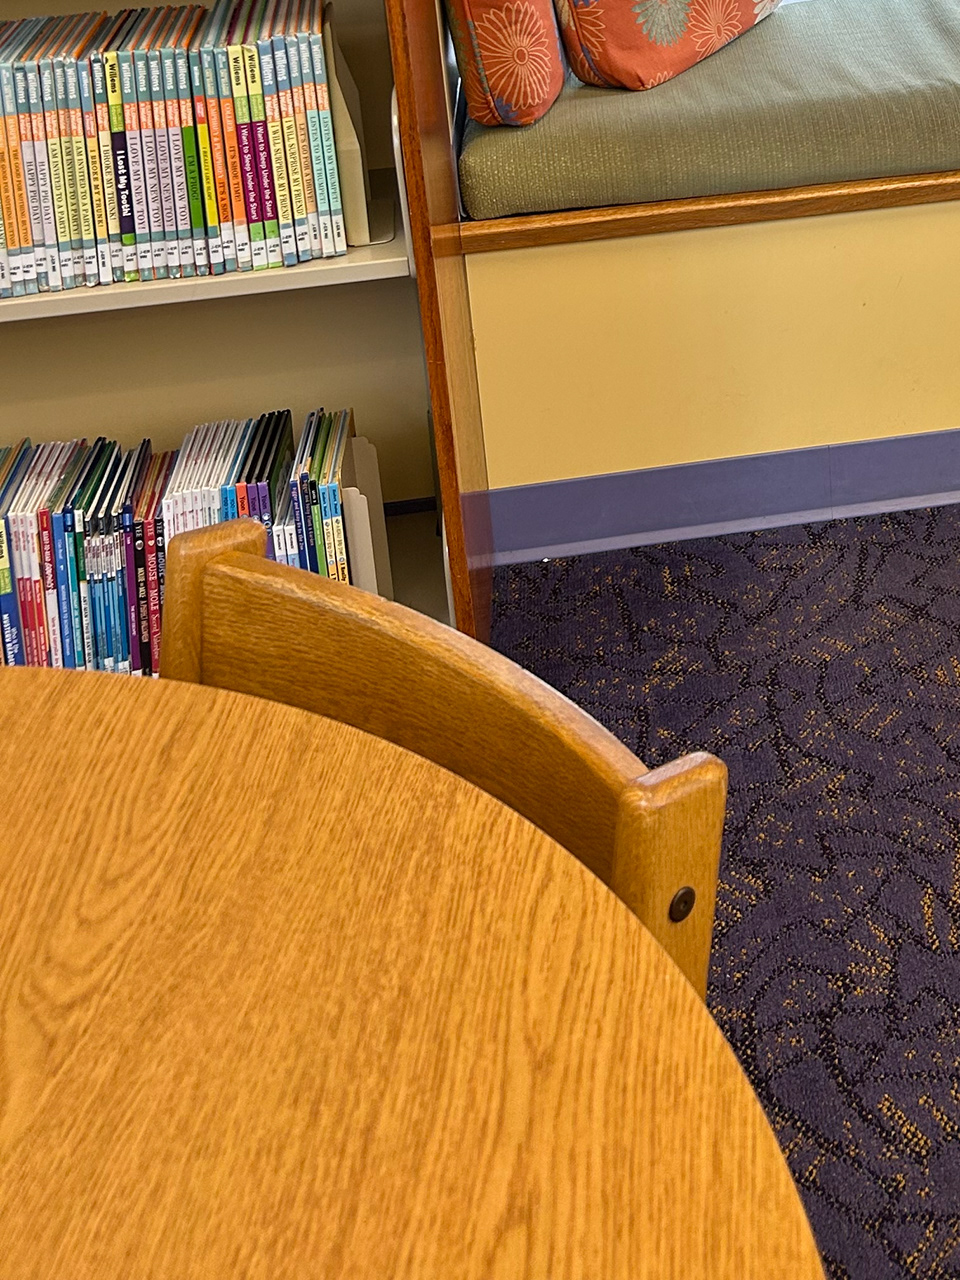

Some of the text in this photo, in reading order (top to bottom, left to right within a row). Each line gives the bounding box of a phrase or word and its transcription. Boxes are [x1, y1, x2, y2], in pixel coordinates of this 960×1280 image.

[233, 56, 241, 86] Willems
[261, 54, 273, 86] Willems
[300, 43, 310, 74] Willems
[312, 44, 322, 75] Willems
[93, 63, 102, 94] Willems
[122, 63, 131, 93] Willems
[137, 61, 146, 92] Willems
[150, 61, 159, 91] Willems
[165, 59, 173, 90] Willems
[177, 59, 187, 89] Willems
[257, 126, 265, 144] Want
[285, 124, 295, 141] WILL
[51, 148, 58, 158] AM
[103, 149, 112, 176] BROKE
[117, 155, 127, 175] Lost
[145, 140, 155, 165] LOVE
[259, 152, 268, 169] Sleep
[288, 143, 299, 176] SURPRISE
[321, 116, 339, 203] LISTEN TO MY TRUMPET!
[52, 160, 62, 191] INVITED
[105, 177, 114, 190] MY
[118, 176, 128, 189] My
[148, 167, 157, 180] MY
[261, 170, 270, 189] Under
[291, 178, 300, 187] MY
[38, 161, 47, 187] HAPPY
[43, 206, 51, 224] DAY!
[55, 194, 63, 202] TO
[149, 183, 159, 204] NEW
[190, 177, 199, 201] FROG!
[263, 189, 272, 199] the
[293, 189, 303, 215] FRIEND!
[107, 192, 116, 220] TRUNK!
[120, 190, 131, 217] Tooth!
[264, 200, 274, 217] Stars!
[57, 210, 66, 237] PARTY!
[151, 206, 161, 228] TOY!
[135, 523, 143, 538] YEE
[147, 553, 156, 581] MOUSE
[150, 589, 159, 611] MOLE
